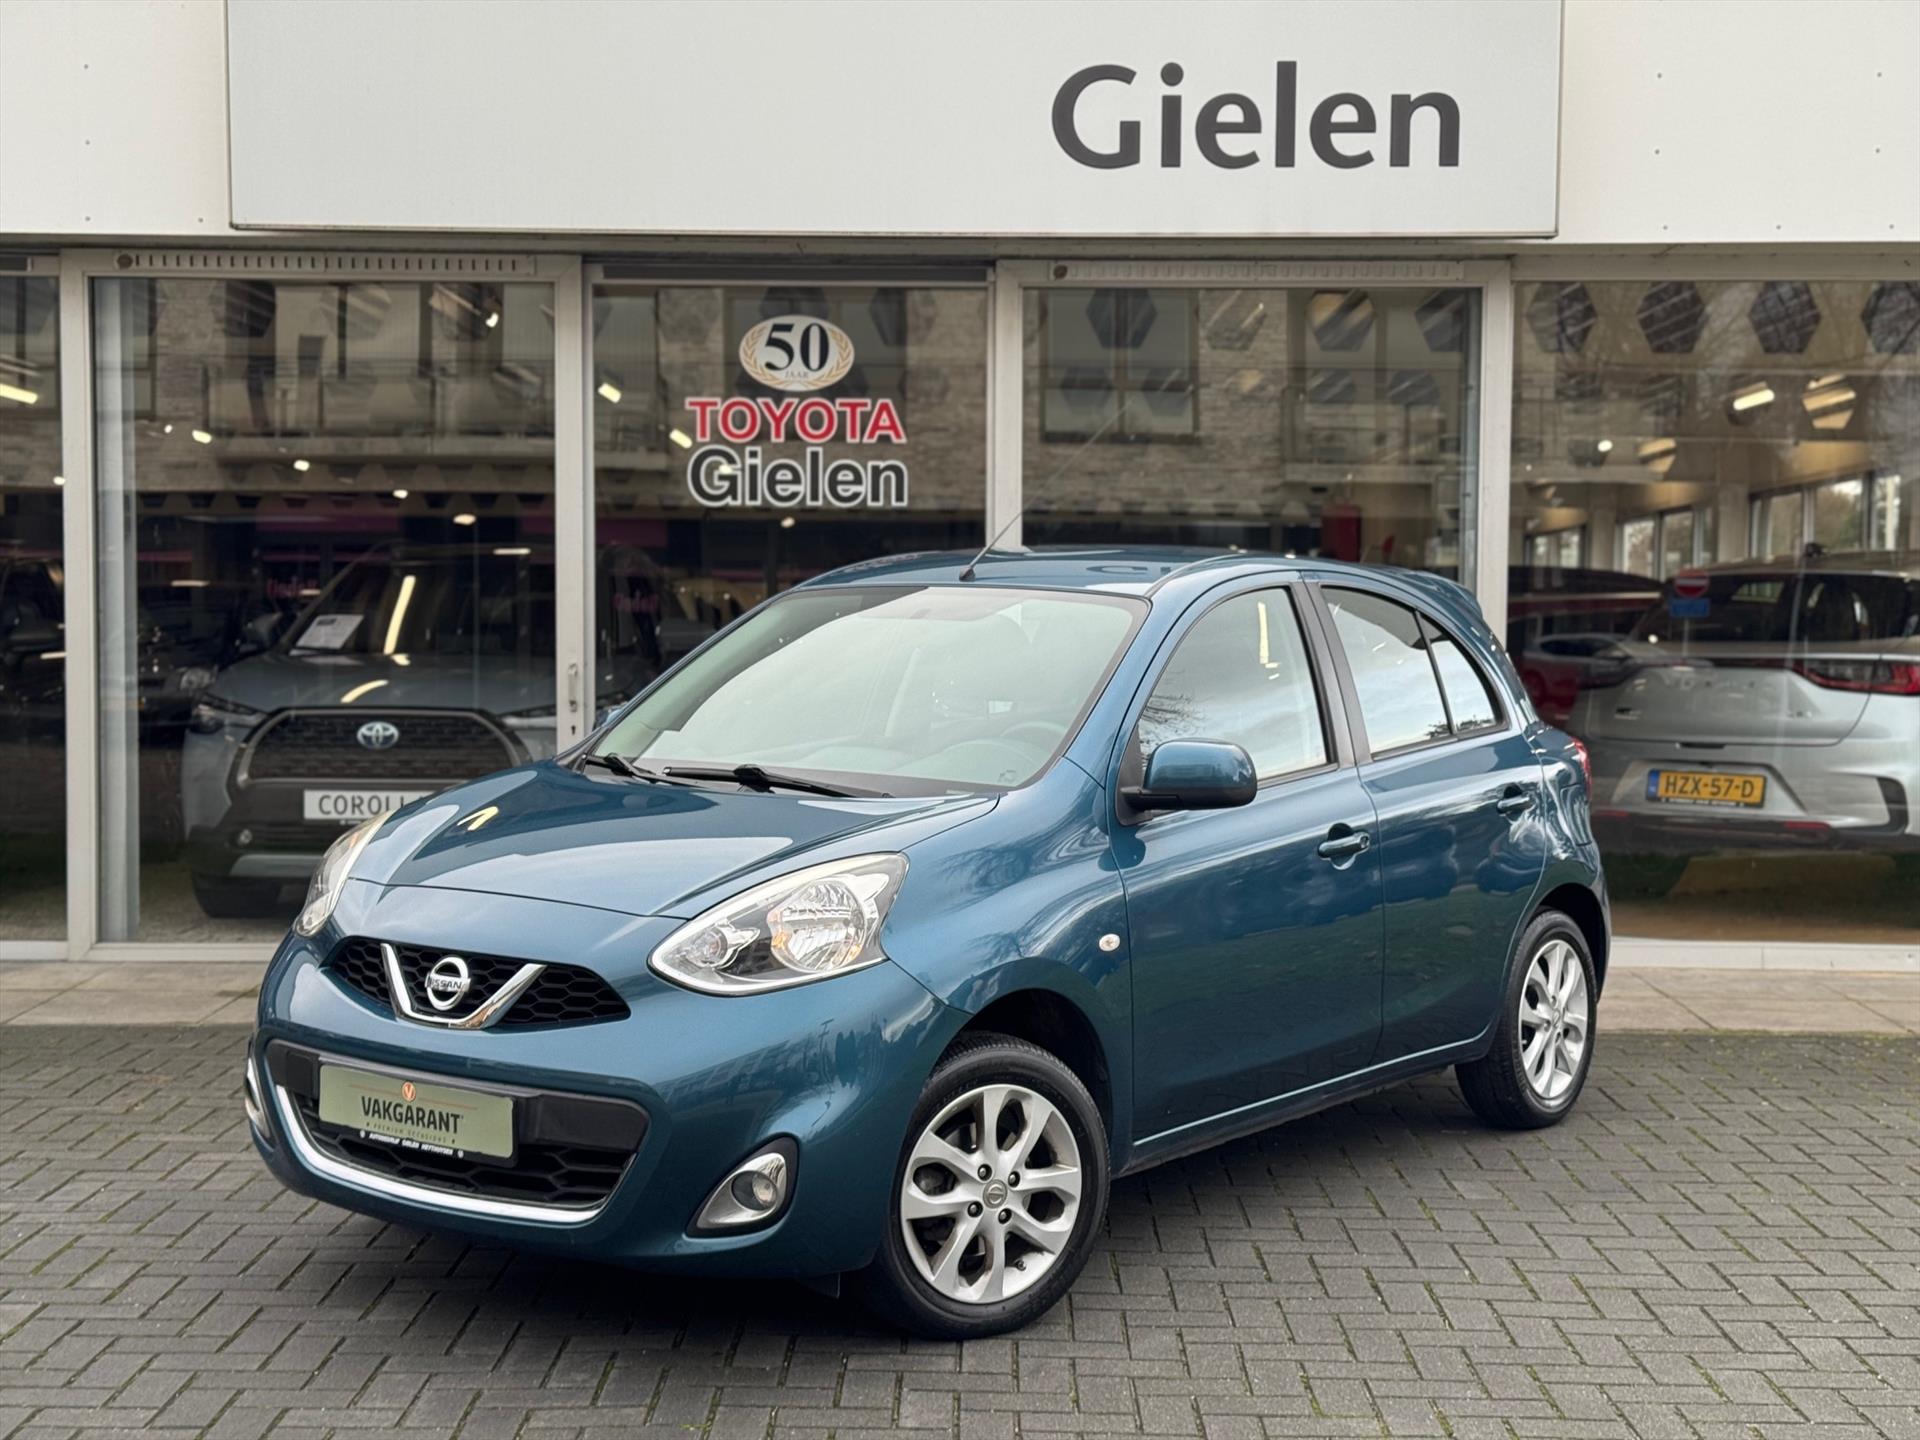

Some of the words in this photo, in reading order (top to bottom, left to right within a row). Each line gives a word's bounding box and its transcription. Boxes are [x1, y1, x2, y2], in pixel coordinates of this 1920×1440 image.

[1051, 60, 1461, 170] Gielen
[764, 322, 830, 373] 50
[686, 398, 906, 443] TOYOTA
[687, 445, 908, 507] Gielen
[1663, 774, 1754, 799] HZX-57-D
[361, 1096, 461, 1134] VAKGARANT
